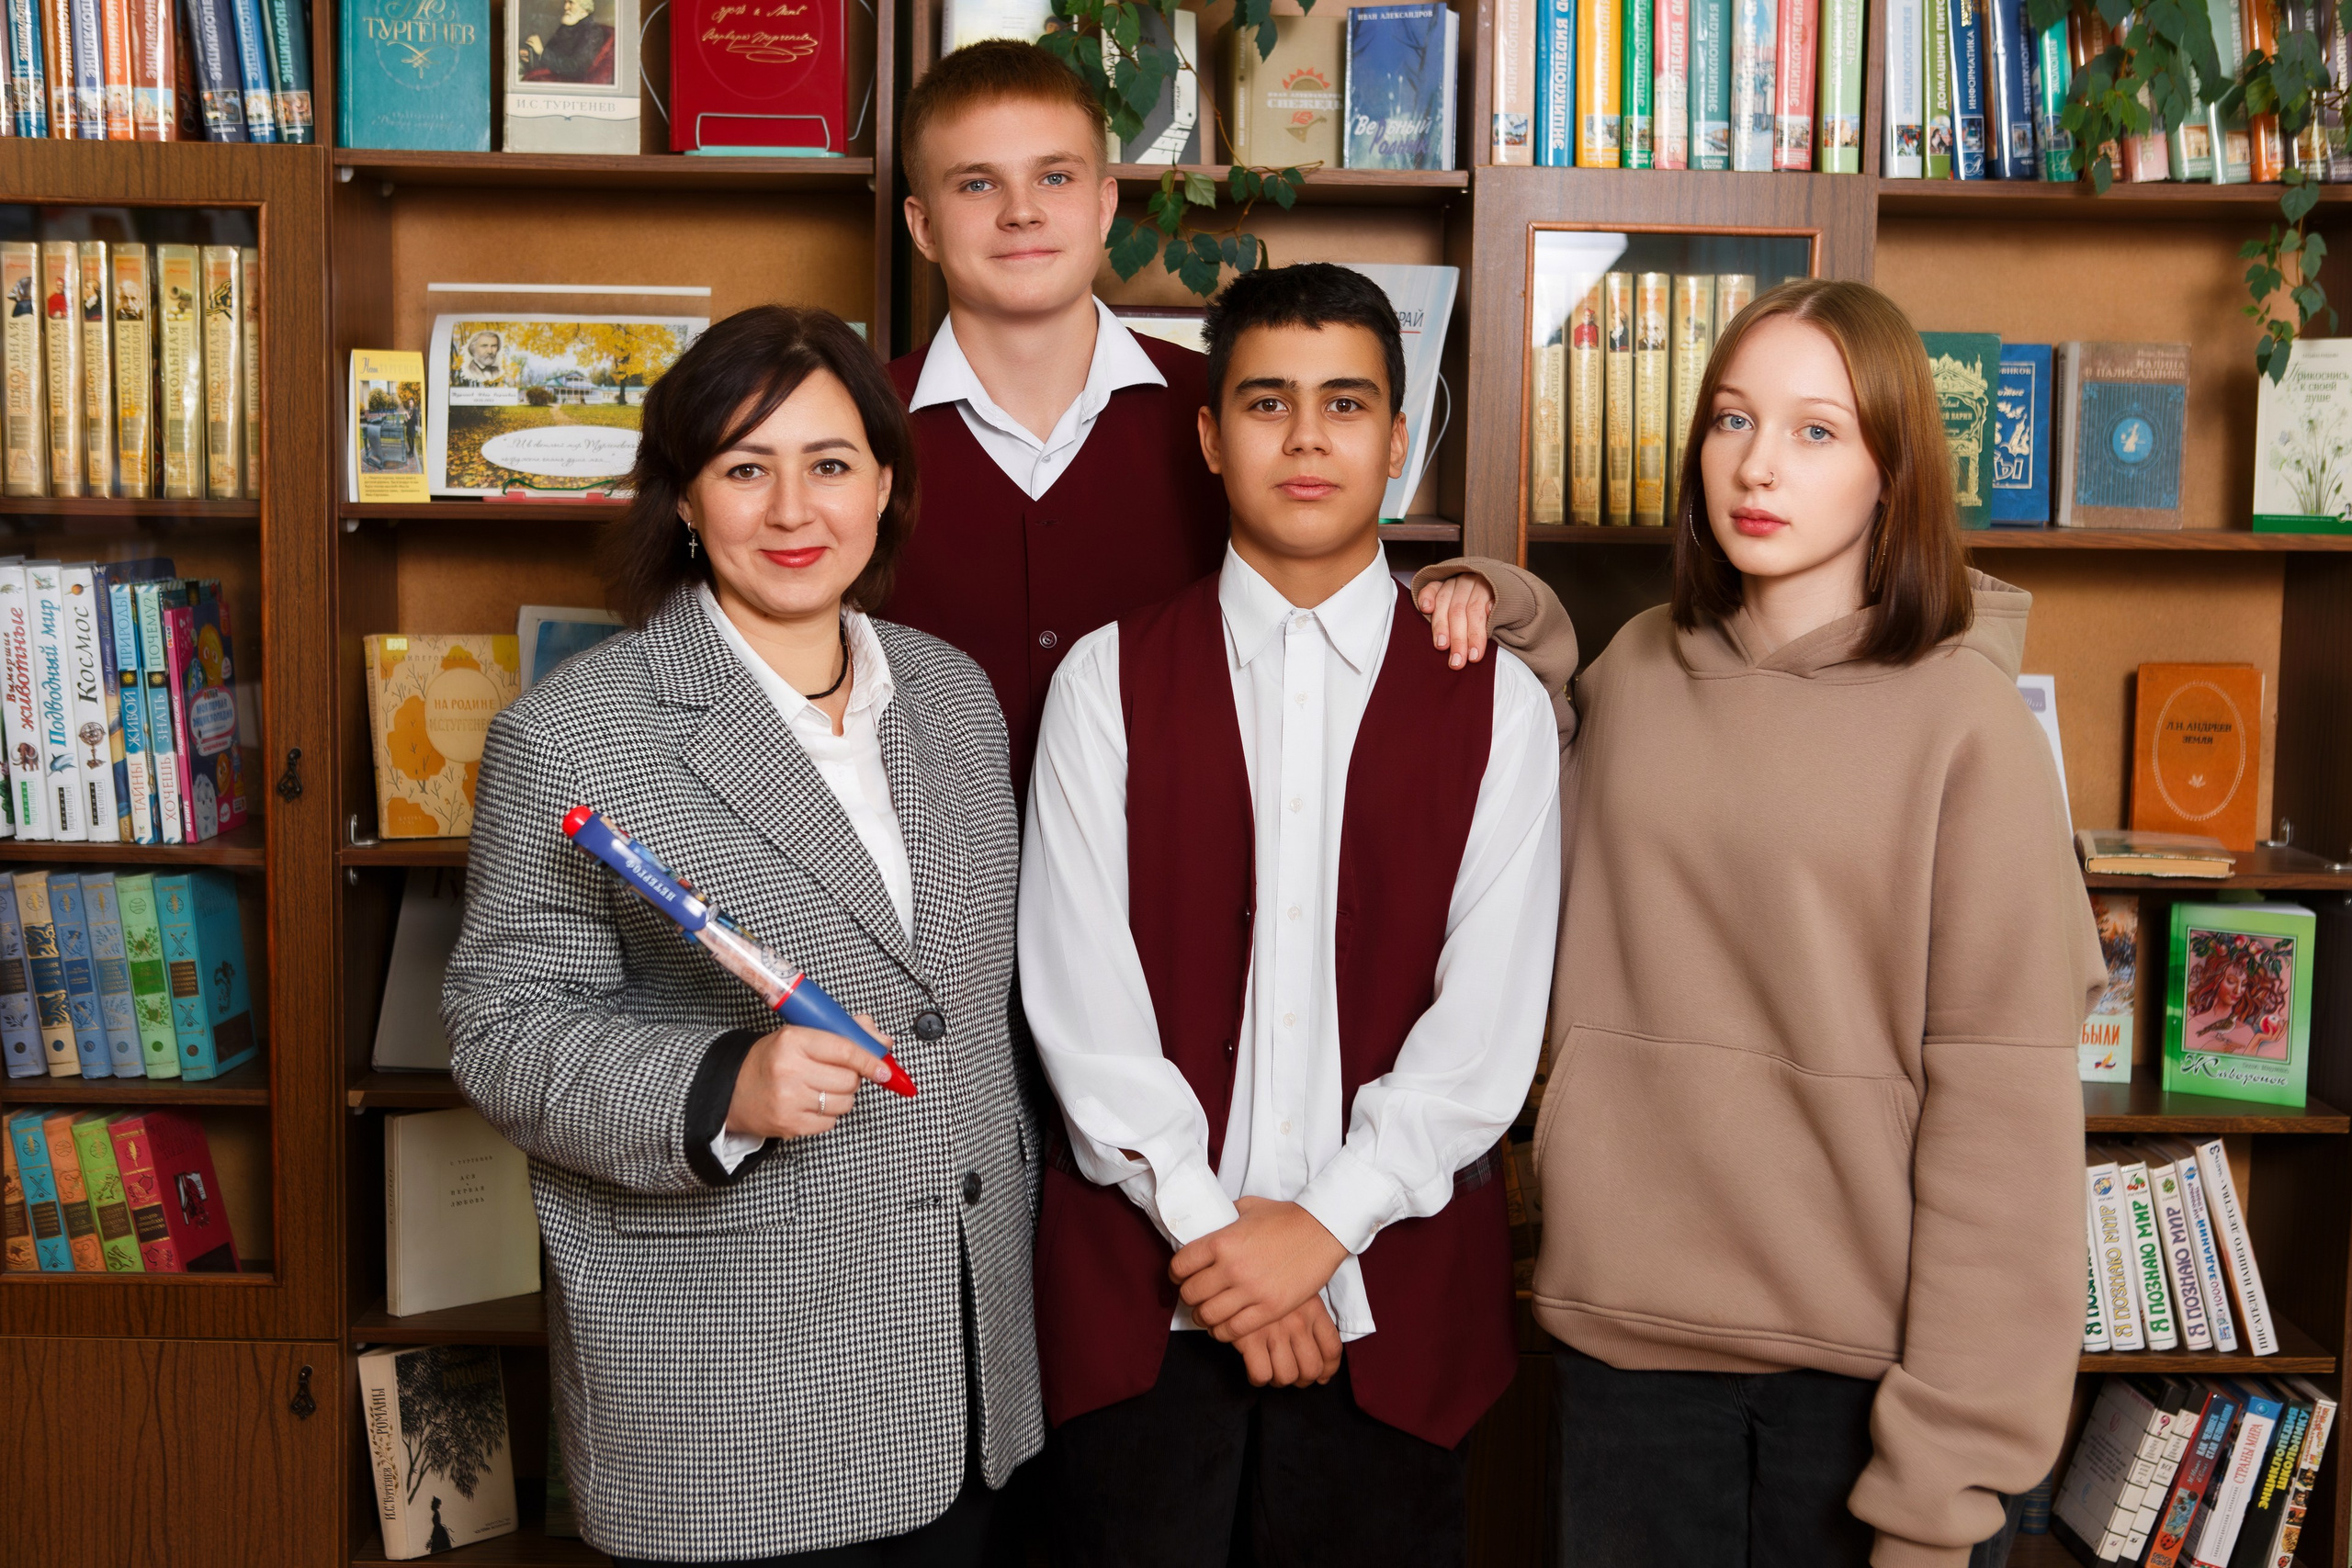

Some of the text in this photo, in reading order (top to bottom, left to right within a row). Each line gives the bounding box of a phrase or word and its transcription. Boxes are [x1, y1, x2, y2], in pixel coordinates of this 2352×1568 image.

[362, 17, 476, 45] ТУРГЕНЕВ
[1357, 10, 1433, 21] ИВАН АЛЕКСАНДРОВ
[1553, 17, 1568, 150] ЭНЦИКЛОПЕДИЯ
[1706, 4, 1720, 112] ЭНЦИКЛОПЕДИЯ
[1936, 33, 1947, 111] ДОМАШНИЕ
[1966, 28, 1977, 110] ИНФОРМАТИКА
[1397, 310, 1424, 328] РАЙ
[2096, 368, 2186, 380] ПАЛИСАДНИКЕ
[2137, 359, 2185, 370] КАЛИНА
[2308, 382, 2337, 391] своей
[2304, 394, 2331, 405] душе
[13, 606, 34, 733] животные
[40, 599, 67, 748] Подводный мир
[74, 605, 98, 705] Космос
[114, 596, 146, 814] ТАЙНЫ ЖИВОЙ ПРИРОДЫ
[144, 597, 176, 821] ХОЧЕШЬ ЗНАТЬ ПОЧЕМУ?
[434, 699, 495, 711] НА РОДИНЕ
[625, 858, 678, 902] ПЕТЕРГОФ
[2082, 1023, 2120, 1047] БЫЛИ
[450, 1185, 485, 1196] ПЕРВАЯ
[2221, 1185, 2241, 1235] ДЕТСТВА
[2099, 1205, 2132, 1337] Я ПОЗНАЮ МИР
[2132, 1200, 2169, 1333] Я ПОЗНАЮ МИР
[2166, 1206, 2206, 1337] Я ПОЗНАЮ МИР
[2197, 1219, 2217, 1281] ЗАДАНИЙ
[2234, 1237, 2252, 1286] НАШЕГО
[2085, 1321, 2102, 1337] Я
[2245, 1290, 2268, 1349] ПИСАТЕЛИ
[375, 1387, 385, 1436] РОМАНЫ
[2233, 1423, 2264, 1484] СТРАНЫ МИРА
[2257, 1406, 2298, 1510] ЭНЦИКЛОПЕДИЯ
[2276, 1409, 2310, 1491] ШКОЛЬНИКУ
